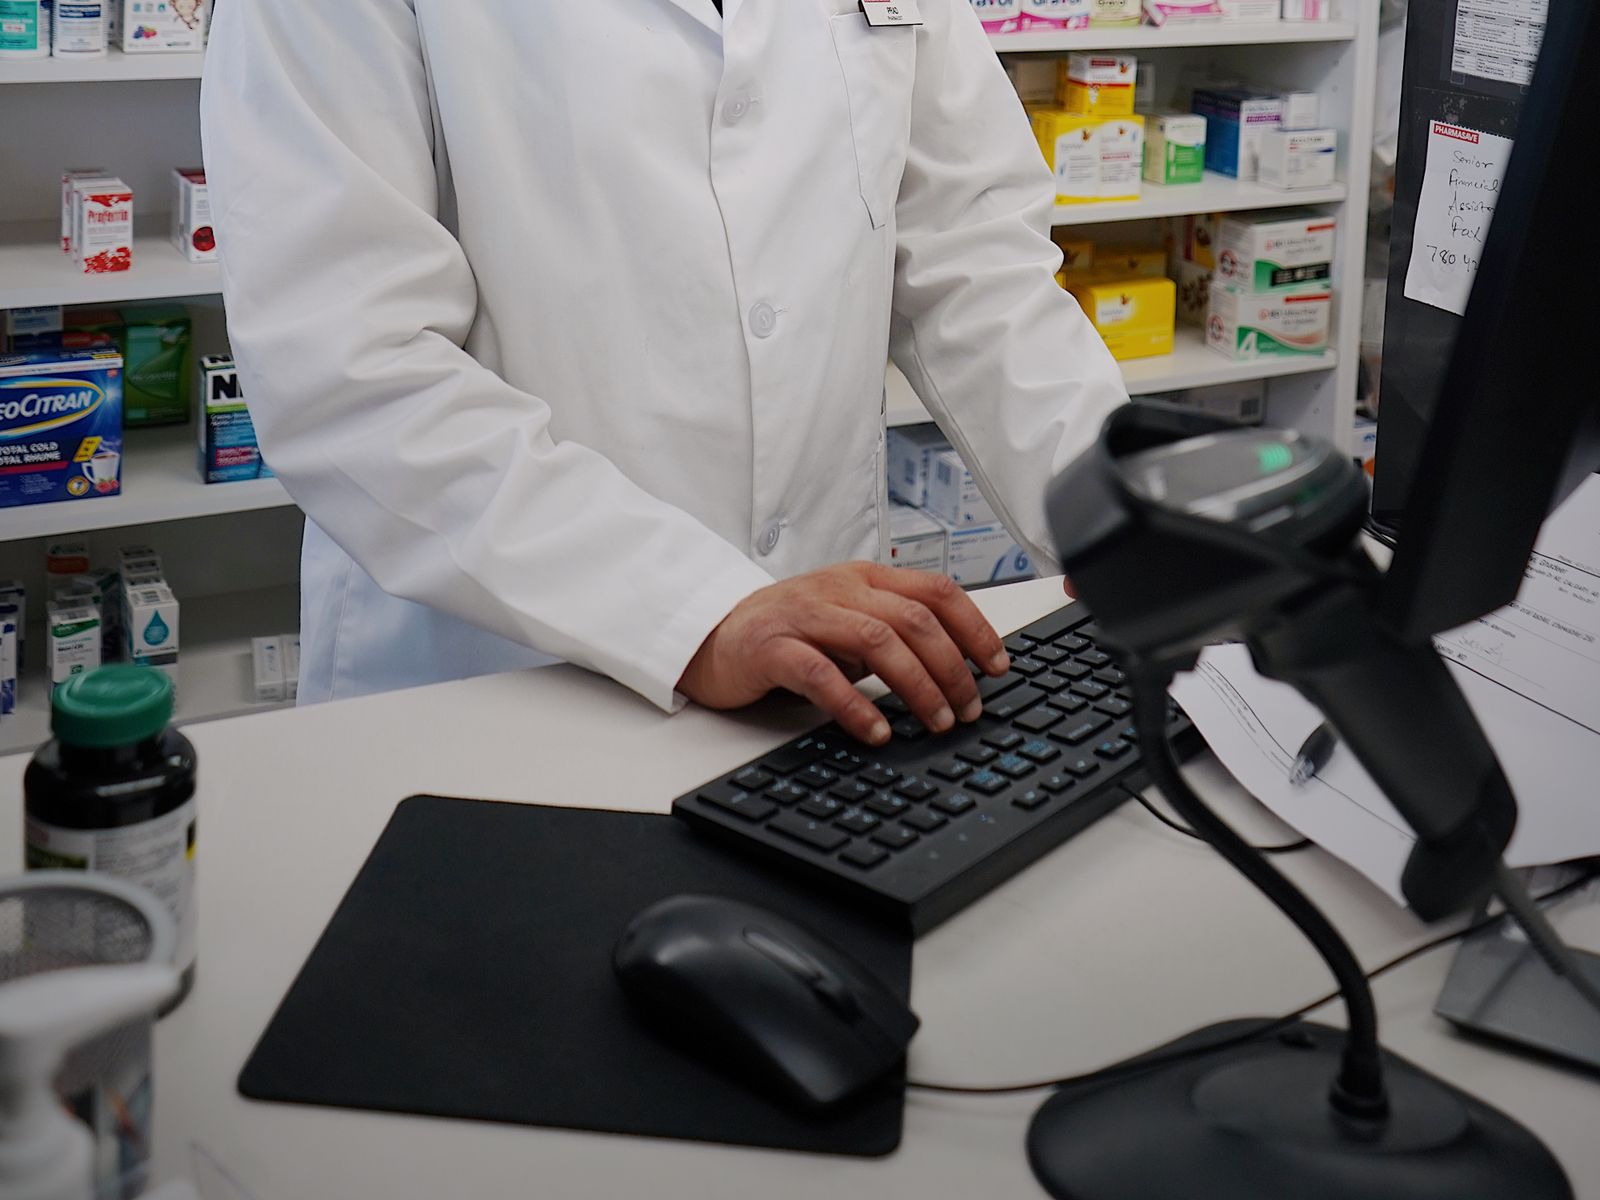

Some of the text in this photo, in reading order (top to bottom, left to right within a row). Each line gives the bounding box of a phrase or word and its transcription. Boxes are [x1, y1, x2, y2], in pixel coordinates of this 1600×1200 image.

[1435, 125, 1479, 143] PHARMASAVE
[1452, 150, 1494, 169] Senior
[1426, 244, 1457, 265] 780
[30, 441, 59, 453] COLD
[1013, 552, 1029, 571] 6
